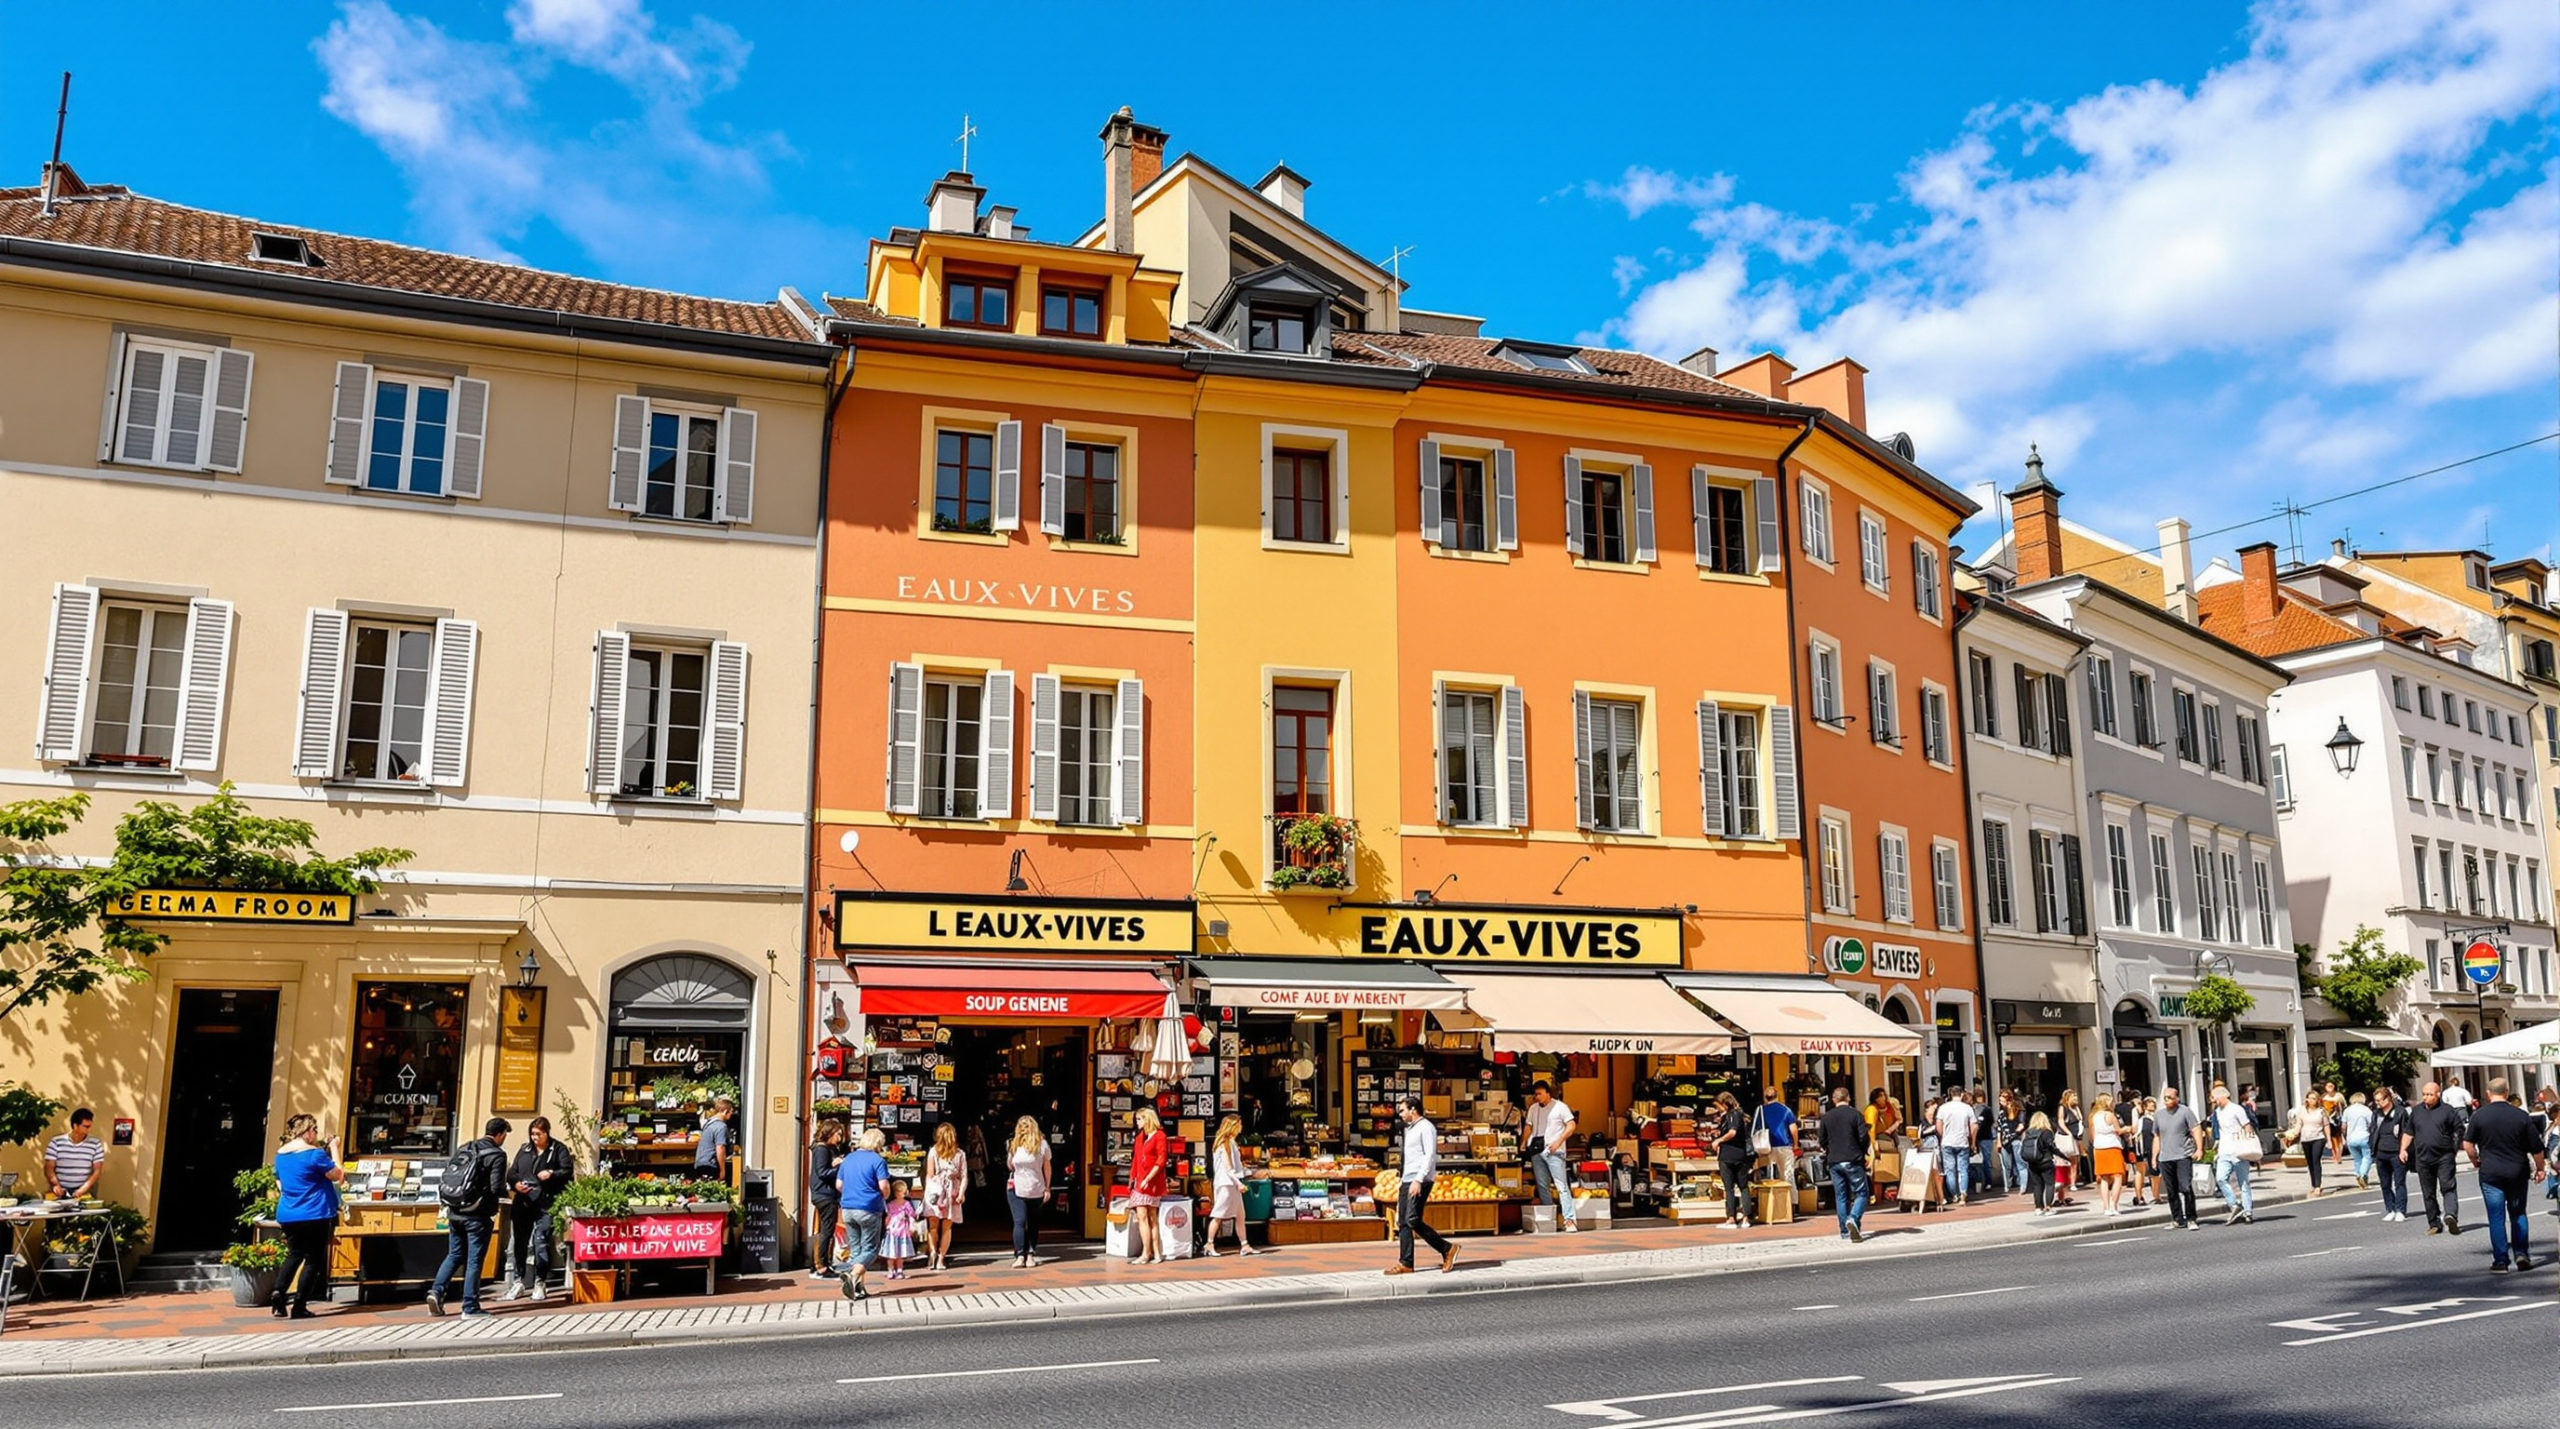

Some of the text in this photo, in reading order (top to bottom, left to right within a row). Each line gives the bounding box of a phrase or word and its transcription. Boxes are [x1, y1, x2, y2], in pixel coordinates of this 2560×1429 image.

[234, 897, 337, 917] FROOM
[956, 911, 1145, 942] EAUX-VIVES
[1361, 915, 1641, 959] EAUX-VIVES
[965, 995, 1069, 1012] SOUP GENENE
